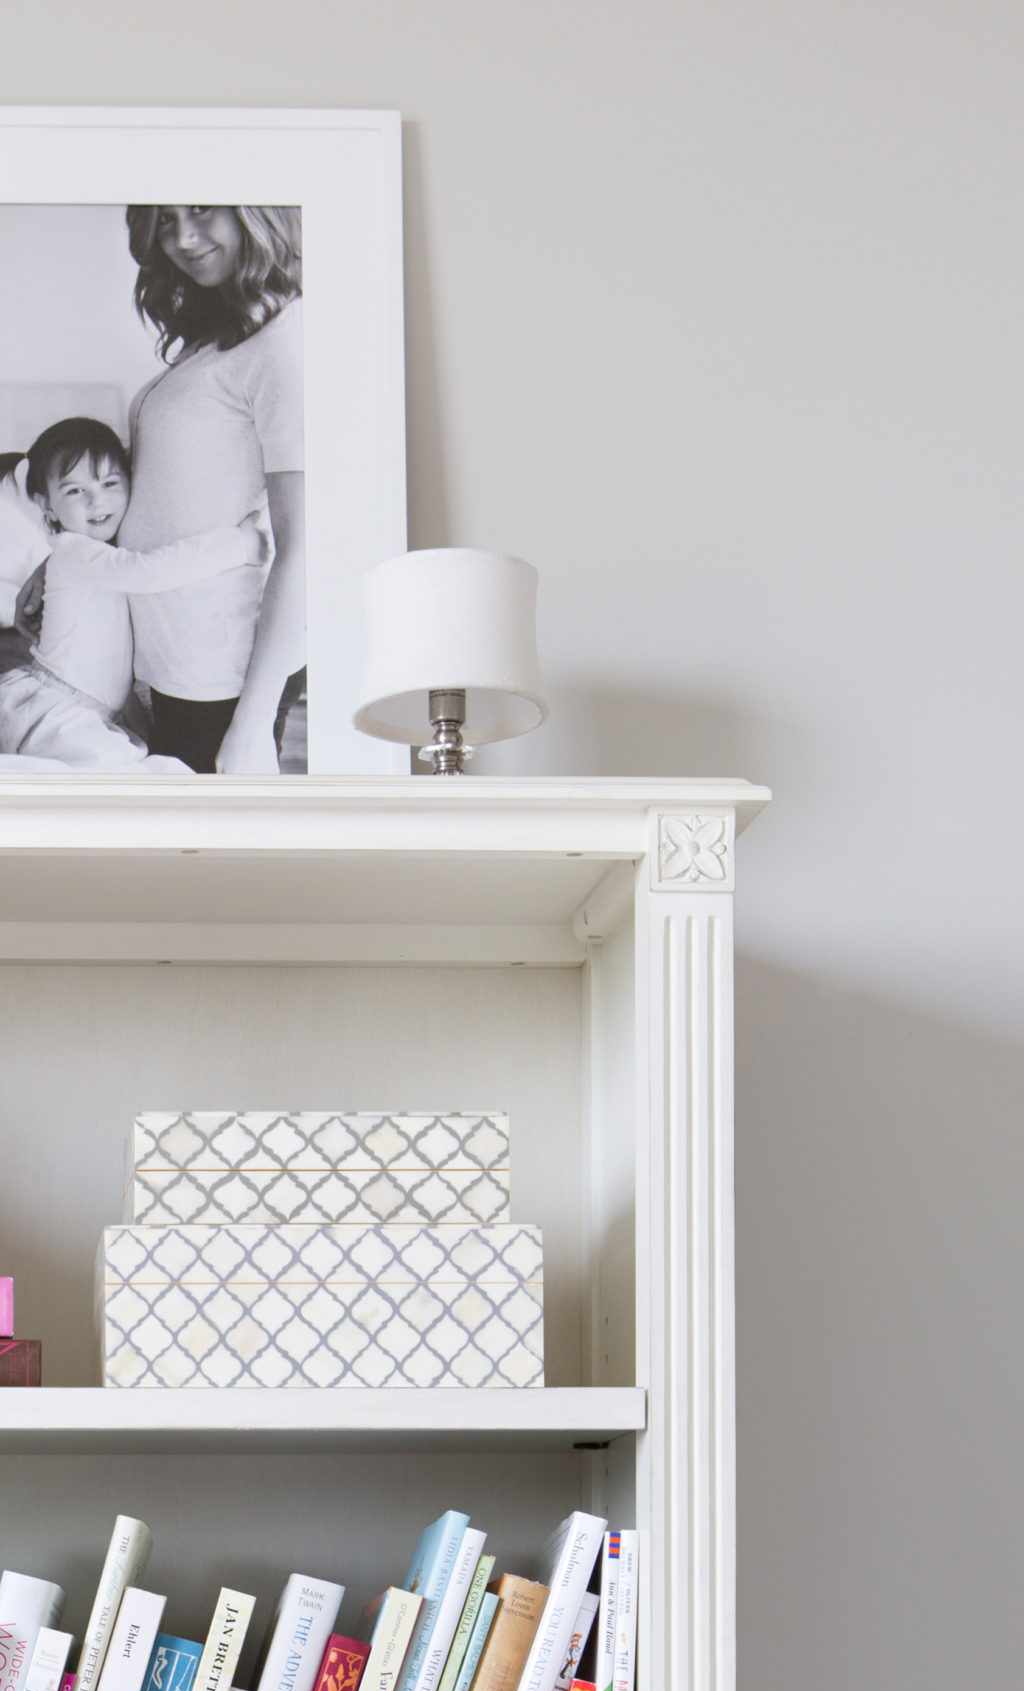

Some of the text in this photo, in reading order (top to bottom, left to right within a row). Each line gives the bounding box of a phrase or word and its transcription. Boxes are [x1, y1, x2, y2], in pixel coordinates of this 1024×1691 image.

[455, 1545, 473, 1585] YAMADA
[559, 1530, 587, 1588] Schulman
[297, 1596, 323, 1611] TWAIN
[300, 1587, 326, 1601] MARK
[458, 1567, 486, 1635] ONE GORILLA
[511, 1591, 534, 1603] Robert
[607, 1579, 616, 1596] Ann
[218, 1602, 239, 1637] JAN
[509, 1599, 534, 1612] Louis
[544, 1604, 564, 1636] YOU
[606, 1608, 614, 1627] Paul
[121, 1623, 140, 1659] Ehlert
[291, 1613, 313, 1647] THE
[604, 1630, 613, 1654] Rand
[422, 1647, 442, 1683] WHAT
[531, 1638, 553, 1677] READ
